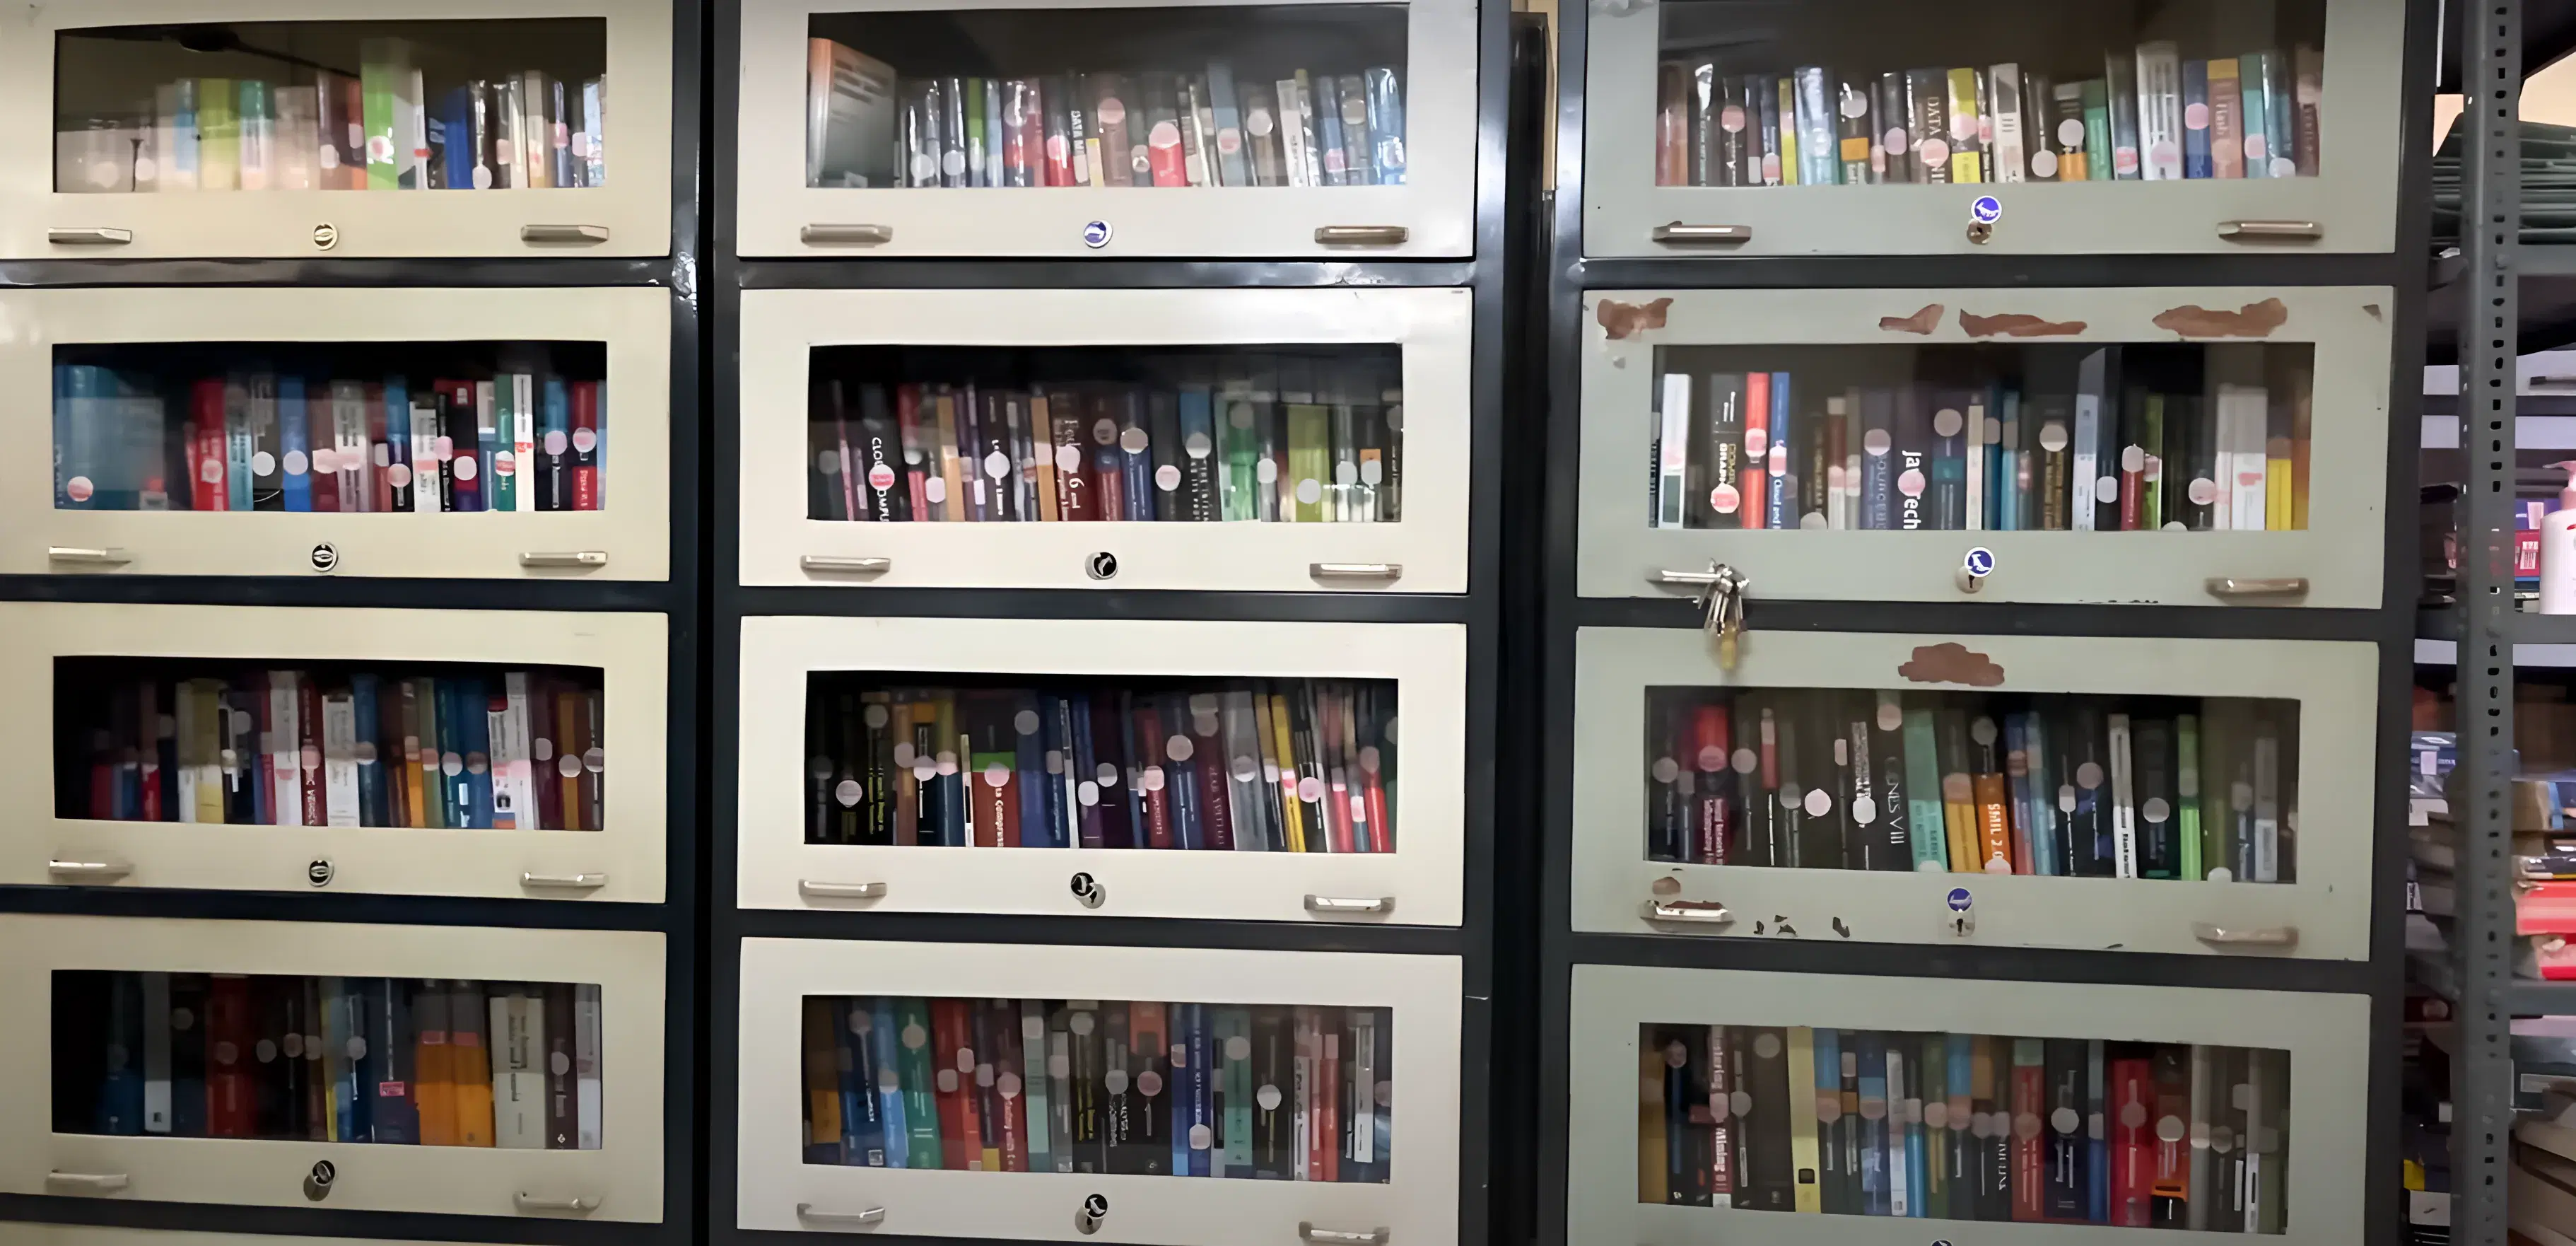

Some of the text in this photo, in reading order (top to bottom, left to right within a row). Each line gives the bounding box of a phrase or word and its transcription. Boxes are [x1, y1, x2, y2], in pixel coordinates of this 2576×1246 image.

[1927, 96, 1942, 136] DATA
[1890, 815, 1905, 844] VIII
[1987, 803, 2003, 834] SMIL
